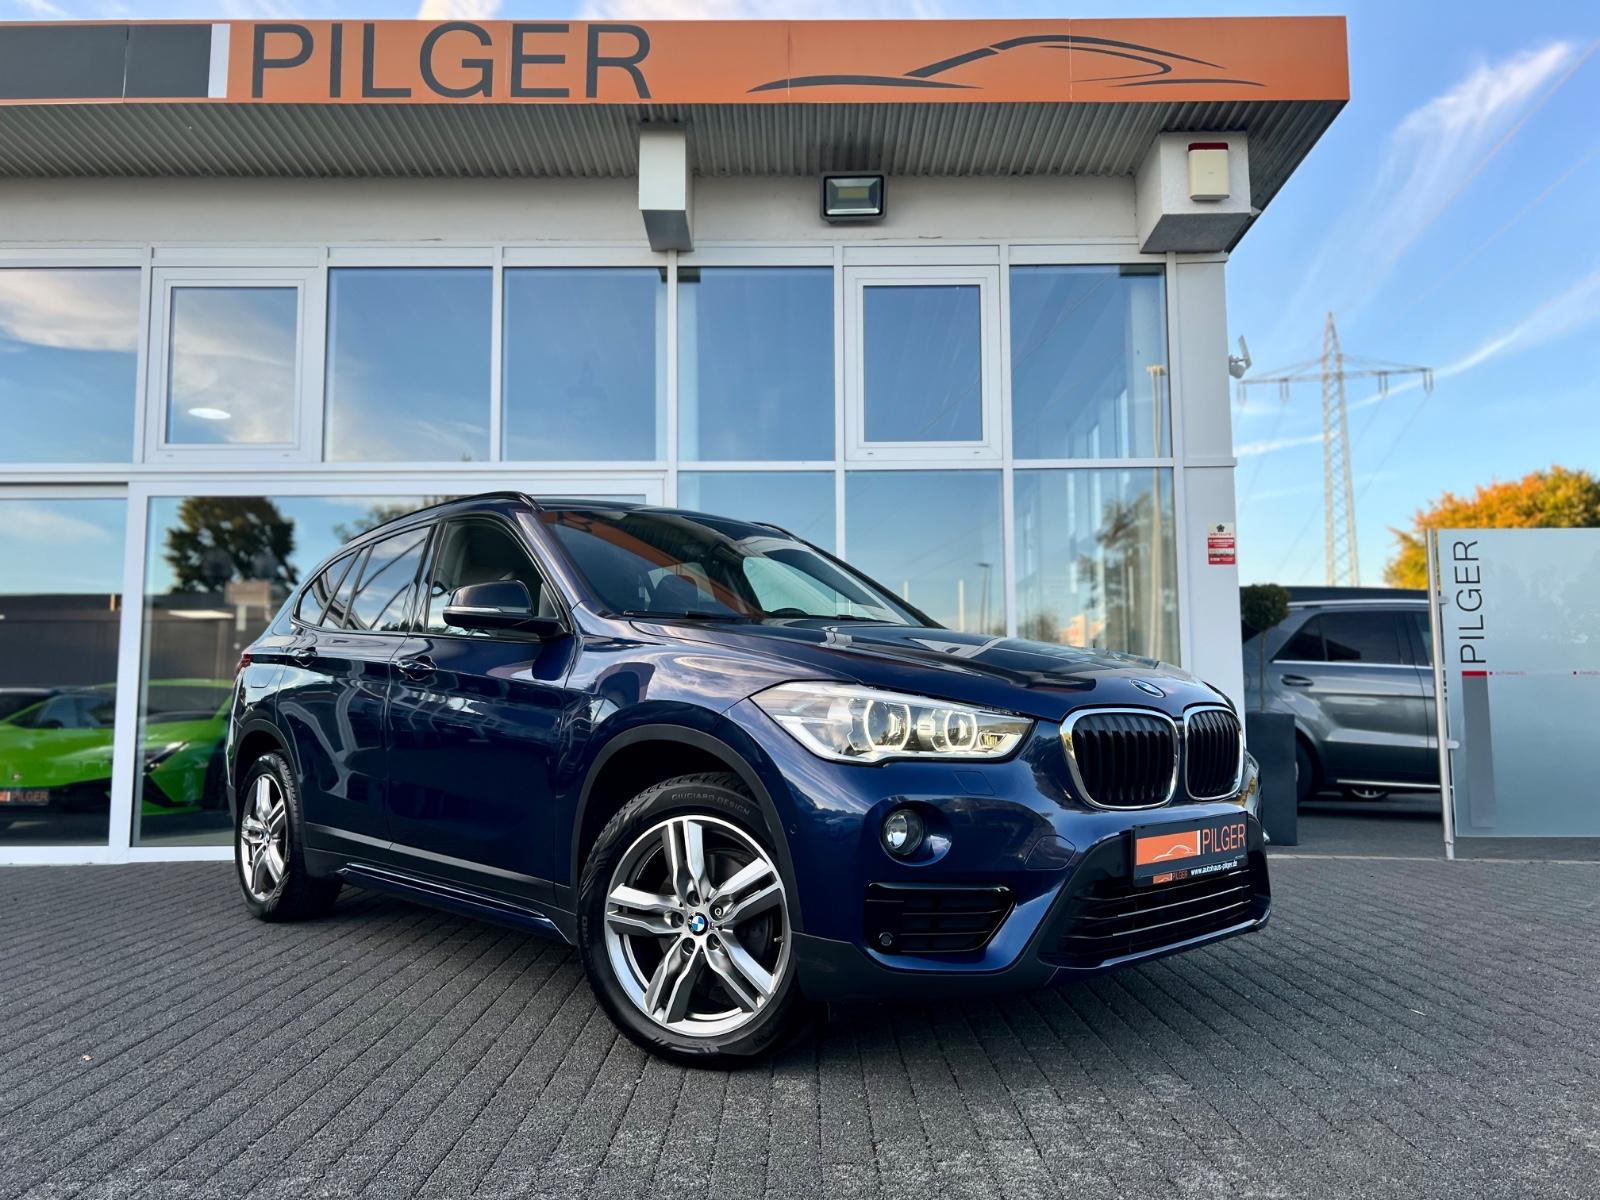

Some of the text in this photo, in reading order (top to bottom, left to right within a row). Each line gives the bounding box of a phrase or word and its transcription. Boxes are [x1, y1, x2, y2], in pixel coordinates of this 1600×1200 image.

[251, 22, 652, 99] PILGER
[1452, 540, 1487, 664] PILGER
[1202, 823, 1246, 855] PILGER
